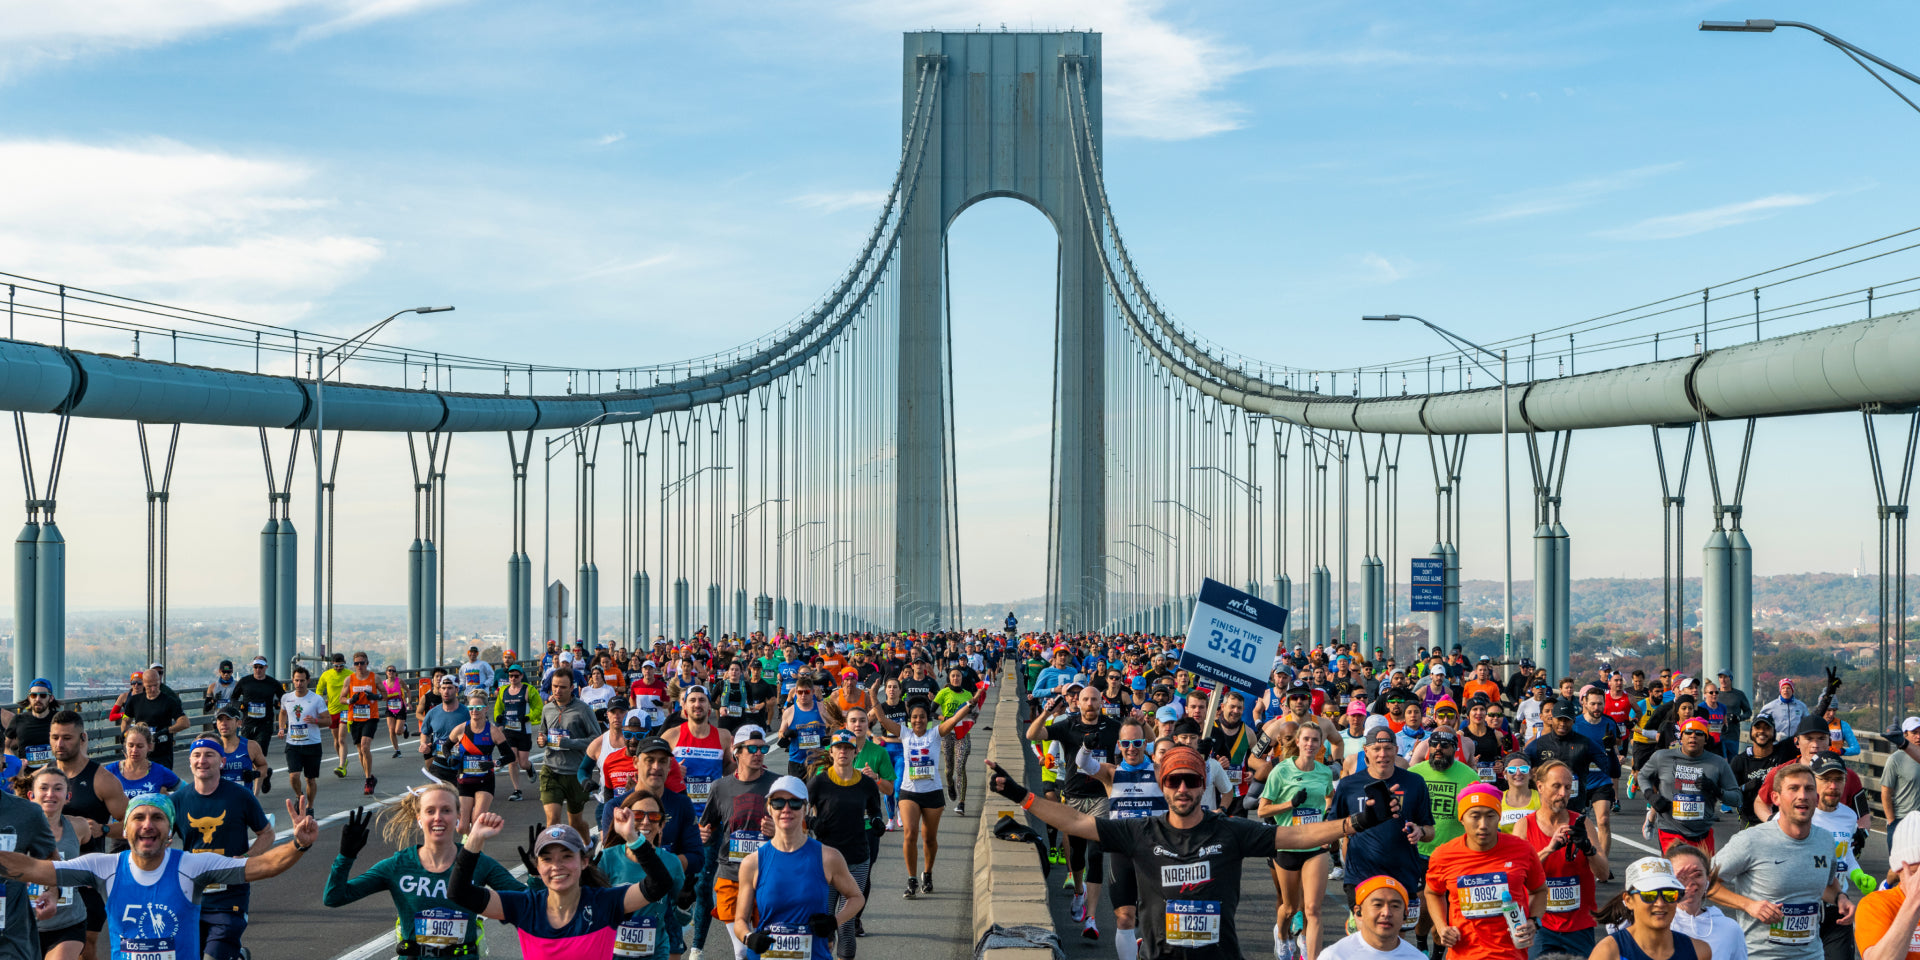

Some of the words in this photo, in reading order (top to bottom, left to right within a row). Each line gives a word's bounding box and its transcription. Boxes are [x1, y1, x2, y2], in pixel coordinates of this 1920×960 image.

[1210, 617, 1241, 636] FINISH
[1243, 630, 1264, 645] TIME
[1207, 629, 1257, 664] 3:40
[1196, 662, 1212, 673] PACE
[1213, 667, 1229, 679] TEAM
[1229, 673, 1252, 688] LEADER
[1676, 764, 1703, 774] REDEFINE
[1428, 784, 1454, 793] ONATE
[1813, 855, 1828, 868] M
[1164, 864, 1207, 883] NACHITO
[399, 875, 448, 899] GRA
[1474, 886, 1498, 902] 9892
[432, 920, 454, 936] 9192
[1184, 915, 1208, 931] 12351
[1786, 916, 1810, 931] 12499
[620, 928, 644, 943] 9450
[776, 936, 801, 950] 9400
